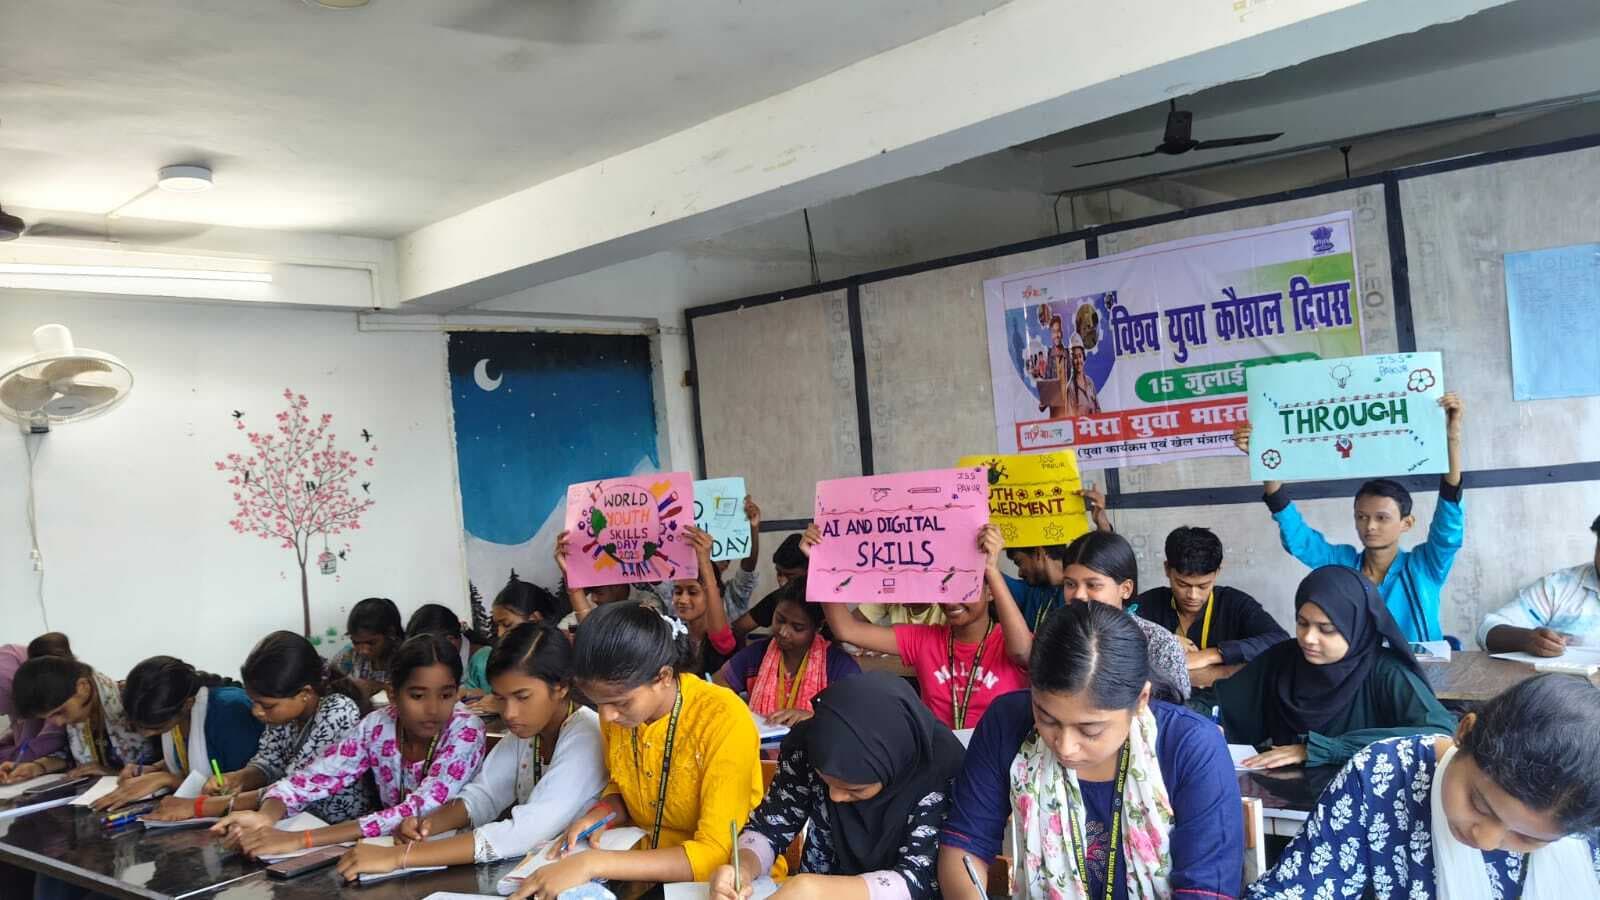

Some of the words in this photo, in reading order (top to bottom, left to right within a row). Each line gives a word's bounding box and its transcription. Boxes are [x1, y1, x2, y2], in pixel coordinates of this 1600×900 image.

[1111, 305, 1160, 356] विश्व
[1165, 305, 1208, 363] युवा
[1211, 287, 1284, 341] कौशल
[1289, 276, 1353, 331] दिवस
[1148, 377, 1174, 394] 15
[1181, 363, 1246, 395] जुलाई
[1076, 416, 1121, 437] मेरा
[1128, 411, 1180, 438] युवा
[1190, 403, 1248, 424] भारत
[1279, 399, 1408, 434] THROUGH
[1078, 446, 1102, 457] (युवा
[1105, 440, 1147, 452] कार्यक्रम
[1150, 438, 1167, 451] एवं
[1170, 436, 1193, 447] खेल
[604, 492, 648, 507] WORLD
[988, 488, 1014, 500] UTH
[606, 507, 650, 526] YOUTH
[988, 498, 1065, 516] WERMENT
[609, 527, 648, 540] SKILLS
[822, 519, 840, 537] AI
[846, 518, 872, 535] AND
[877, 515, 945, 534] DIGITAL
[617, 540, 638, 550] DAY
[712, 536, 749, 557] DAY
[856, 540, 935, 567] SKILLS
